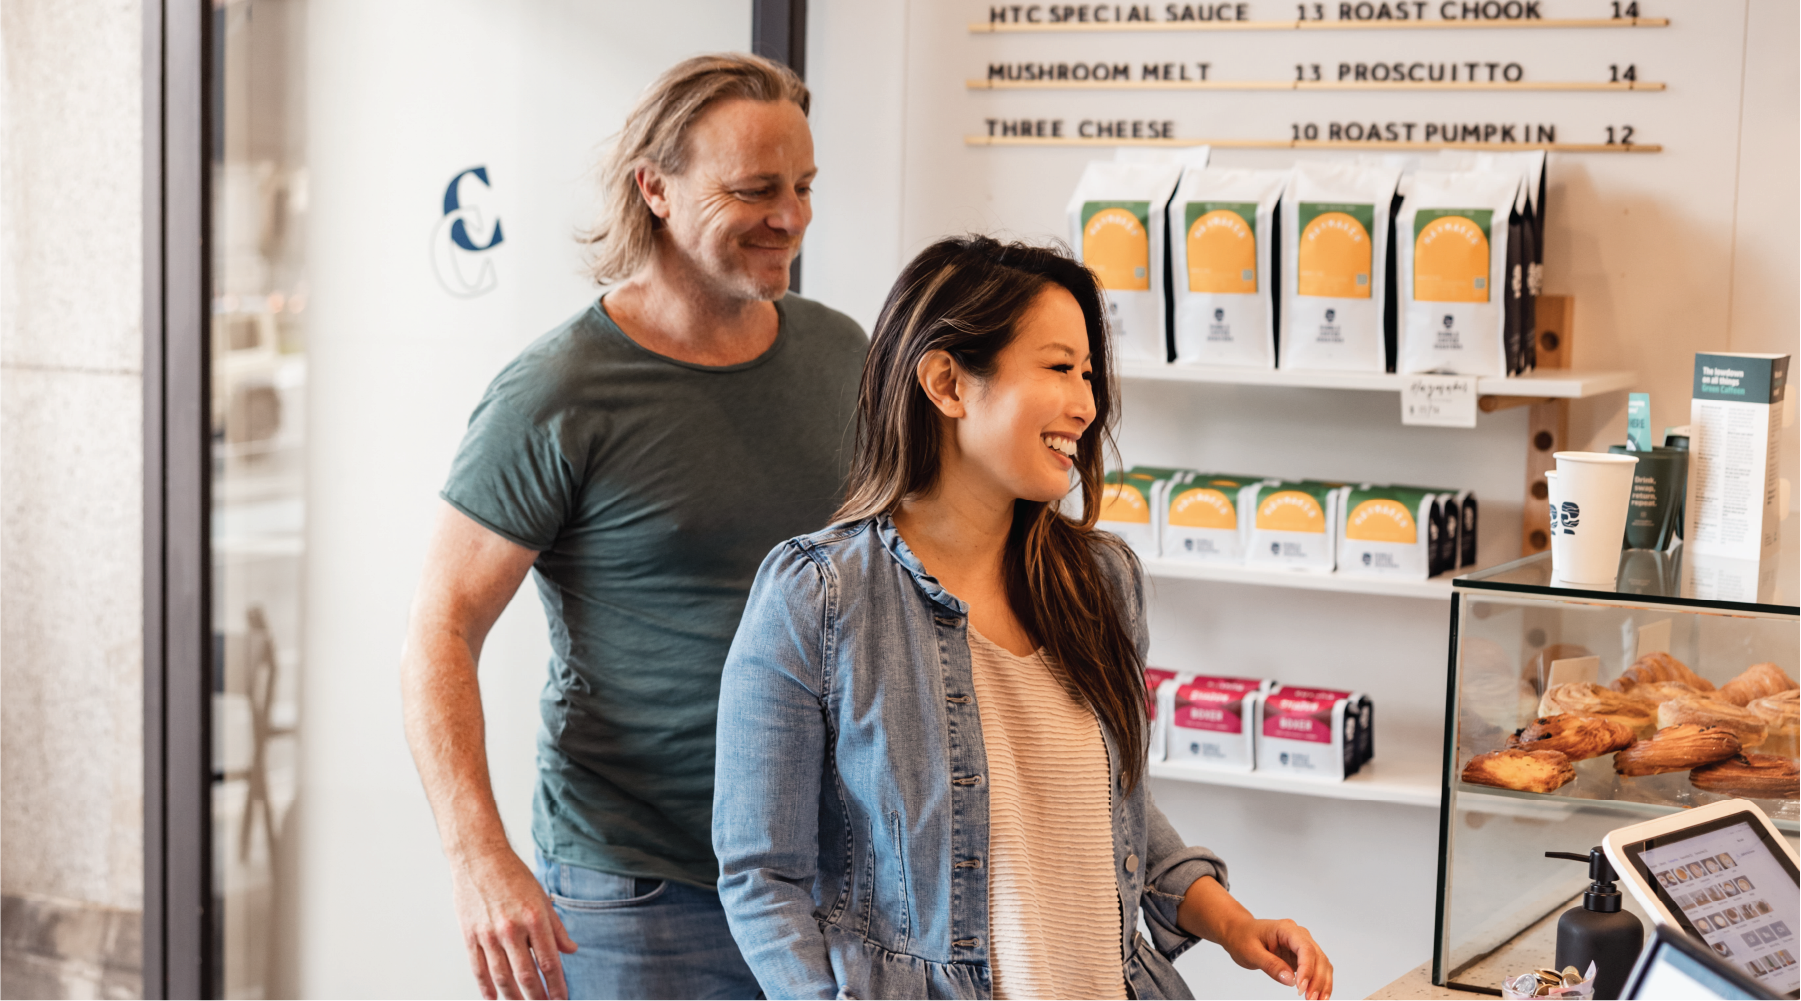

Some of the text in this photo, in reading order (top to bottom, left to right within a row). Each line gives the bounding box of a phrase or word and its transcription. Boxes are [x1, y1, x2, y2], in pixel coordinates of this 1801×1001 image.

[989, 3, 1324, 24] HTC SPECIAL SAUCE 13
[1339, 0, 1640, 21] ROAST CHOOK 14
[987, 63, 1321, 82] MUSHROOM MELT 13
[1337, 63, 1637, 83] PROSCUITTO 14
[985, 119, 1319, 141] THREE CHEESE 10
[1328, 122, 1635, 145] ROAST PUMPKIN 12
[1702, 366, 1744, 378] The lowdown
